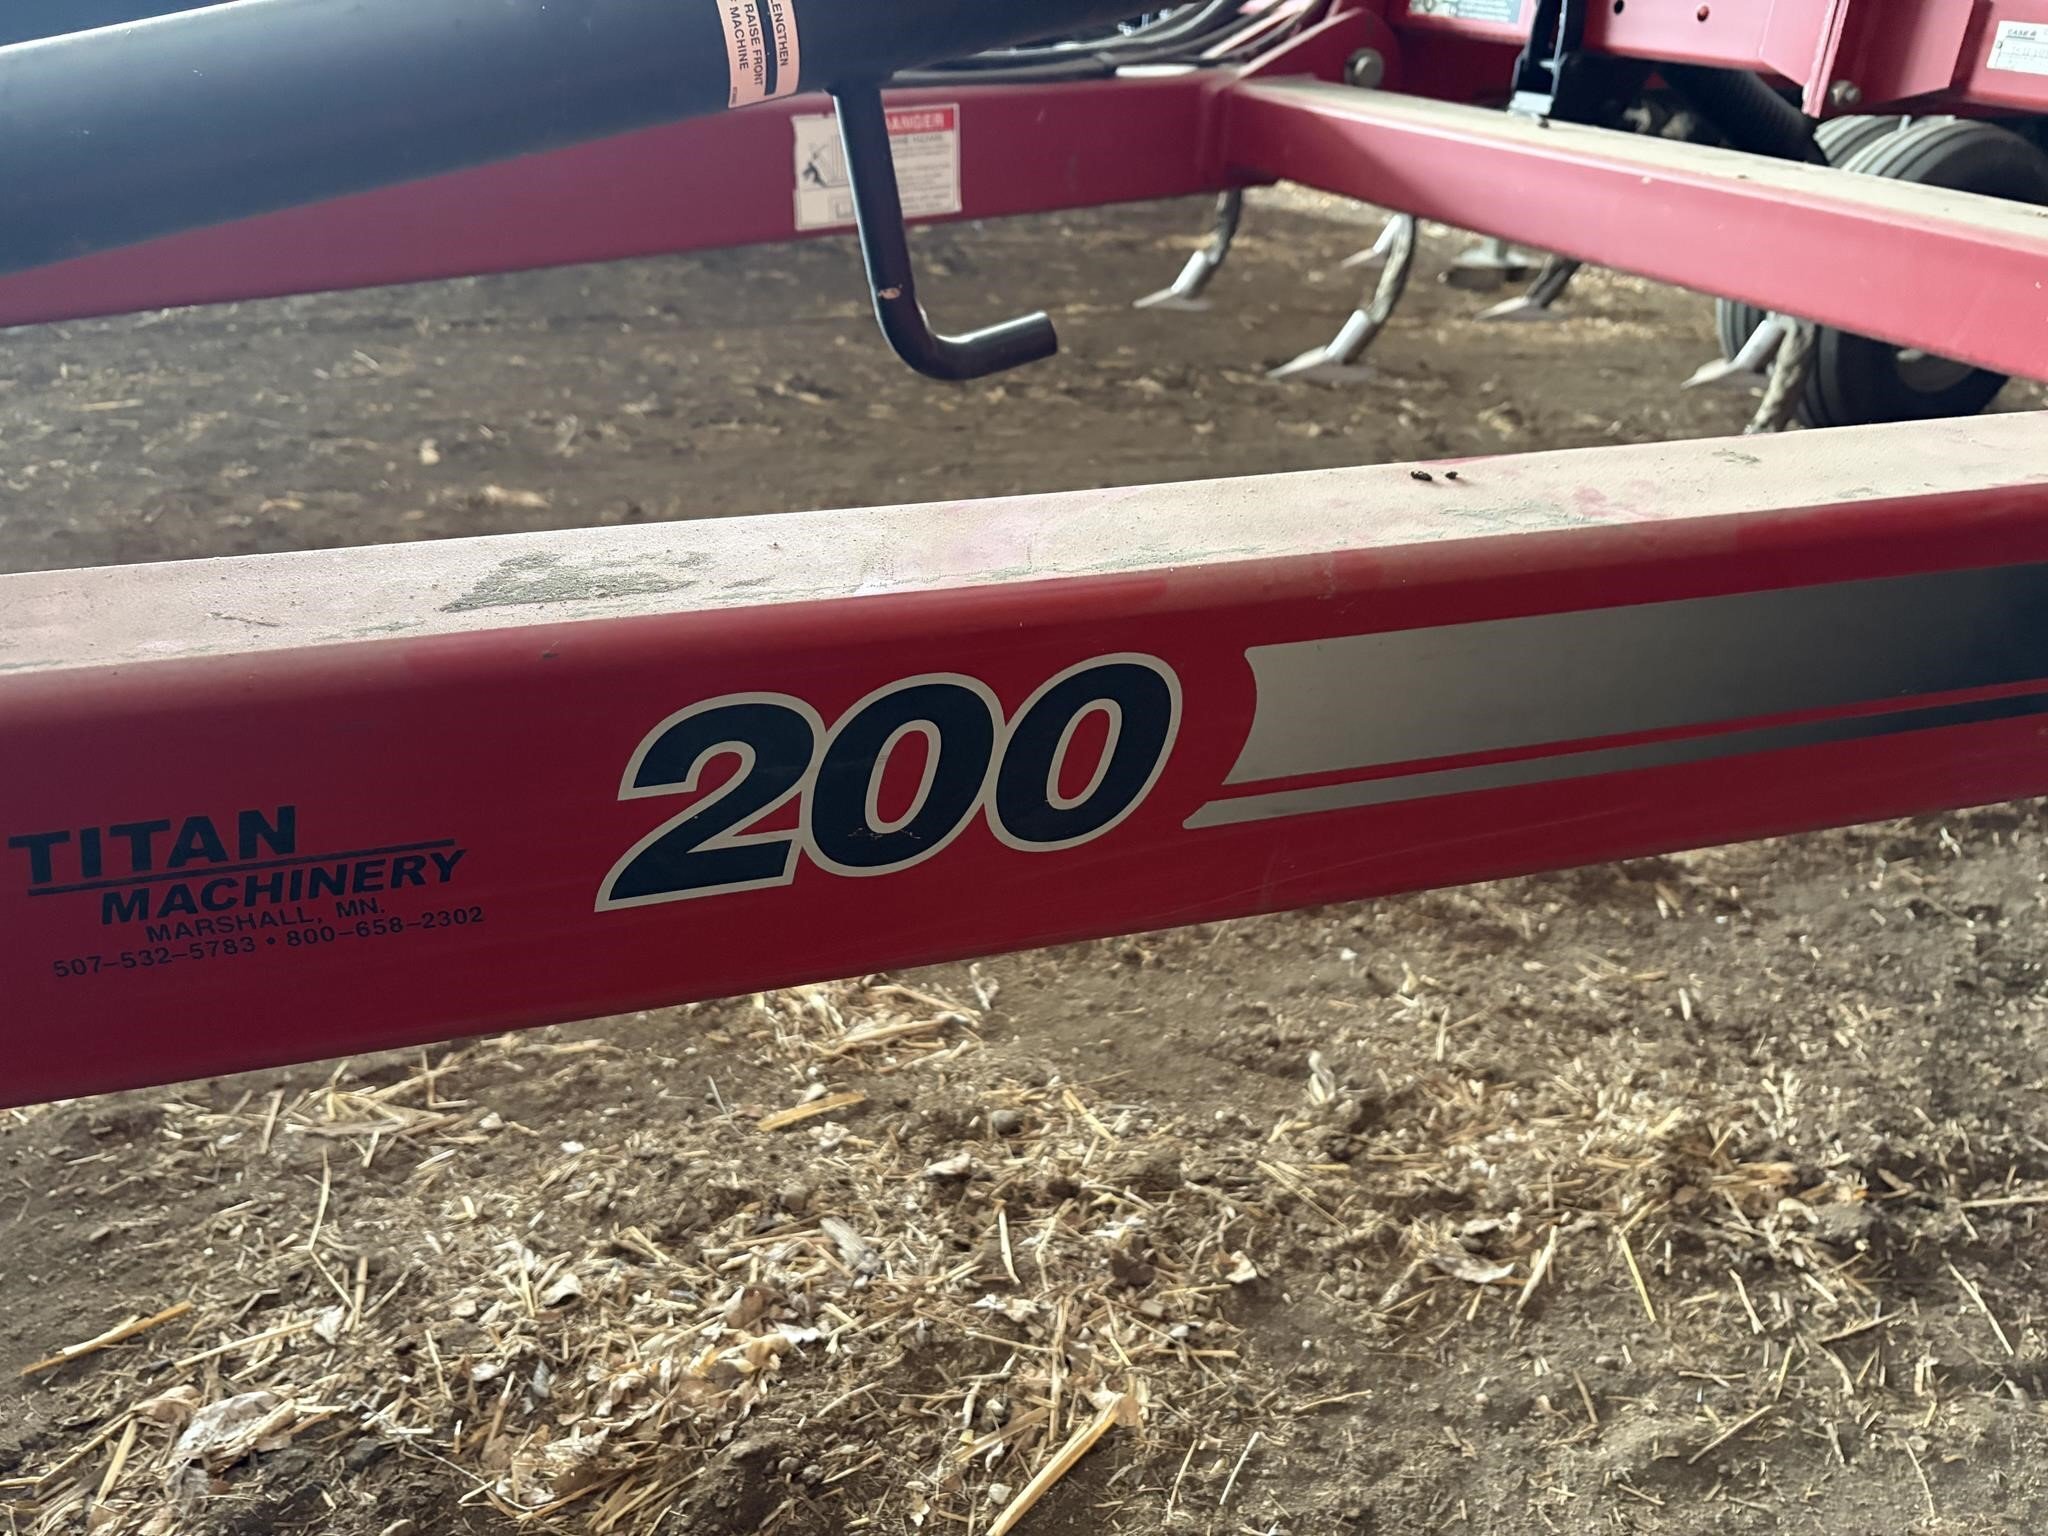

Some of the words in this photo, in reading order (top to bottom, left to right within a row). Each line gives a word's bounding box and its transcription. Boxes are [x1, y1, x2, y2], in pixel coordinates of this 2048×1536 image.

[729, 6, 749, 71] MACHINE
[744, 3, 761, 46] RAISE
[752, 49, 763, 86] FRONT
[886, 112, 946, 131] ANGER
[595, 652, 1183, 912] 200
[8, 805, 296, 885] TITAN
[101, 849, 467, 926] MACHINERY
[146, 906, 322, 943] MARSHALL,
[336, 897, 385, 919] MN.
[54, 936, 256, 977] 507-532-5783
[287, 906, 485, 947] 800-658-2302
